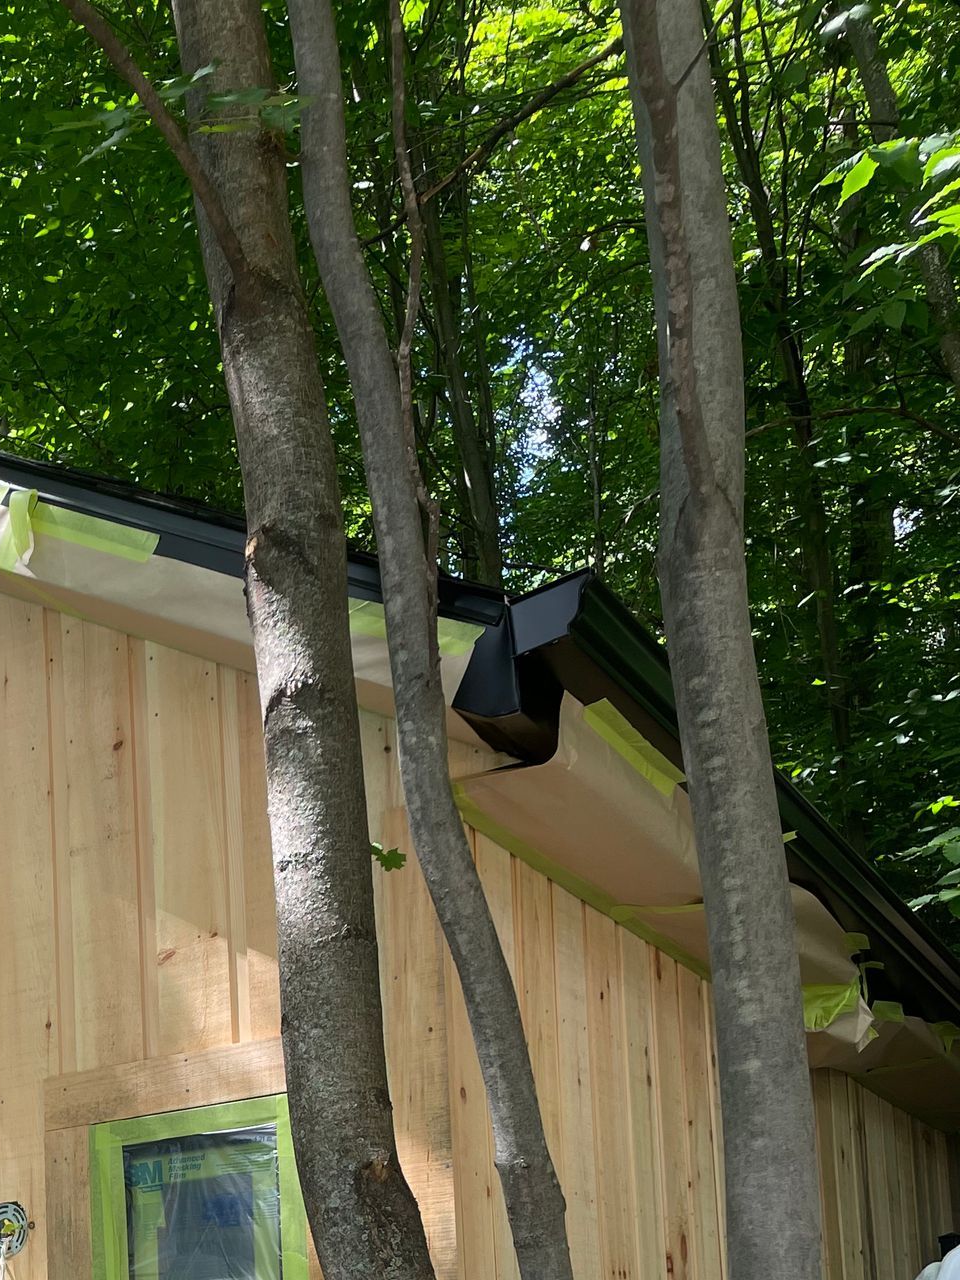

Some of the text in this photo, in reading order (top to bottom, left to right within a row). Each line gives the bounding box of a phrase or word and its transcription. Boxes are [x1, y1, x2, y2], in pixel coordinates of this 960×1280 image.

[167, 1153, 206, 1164] Advanced
[168, 1162, 202, 1172] Masking
[129, 1160, 163, 1187] 3M
[169, 1172, 187, 1181] Film
